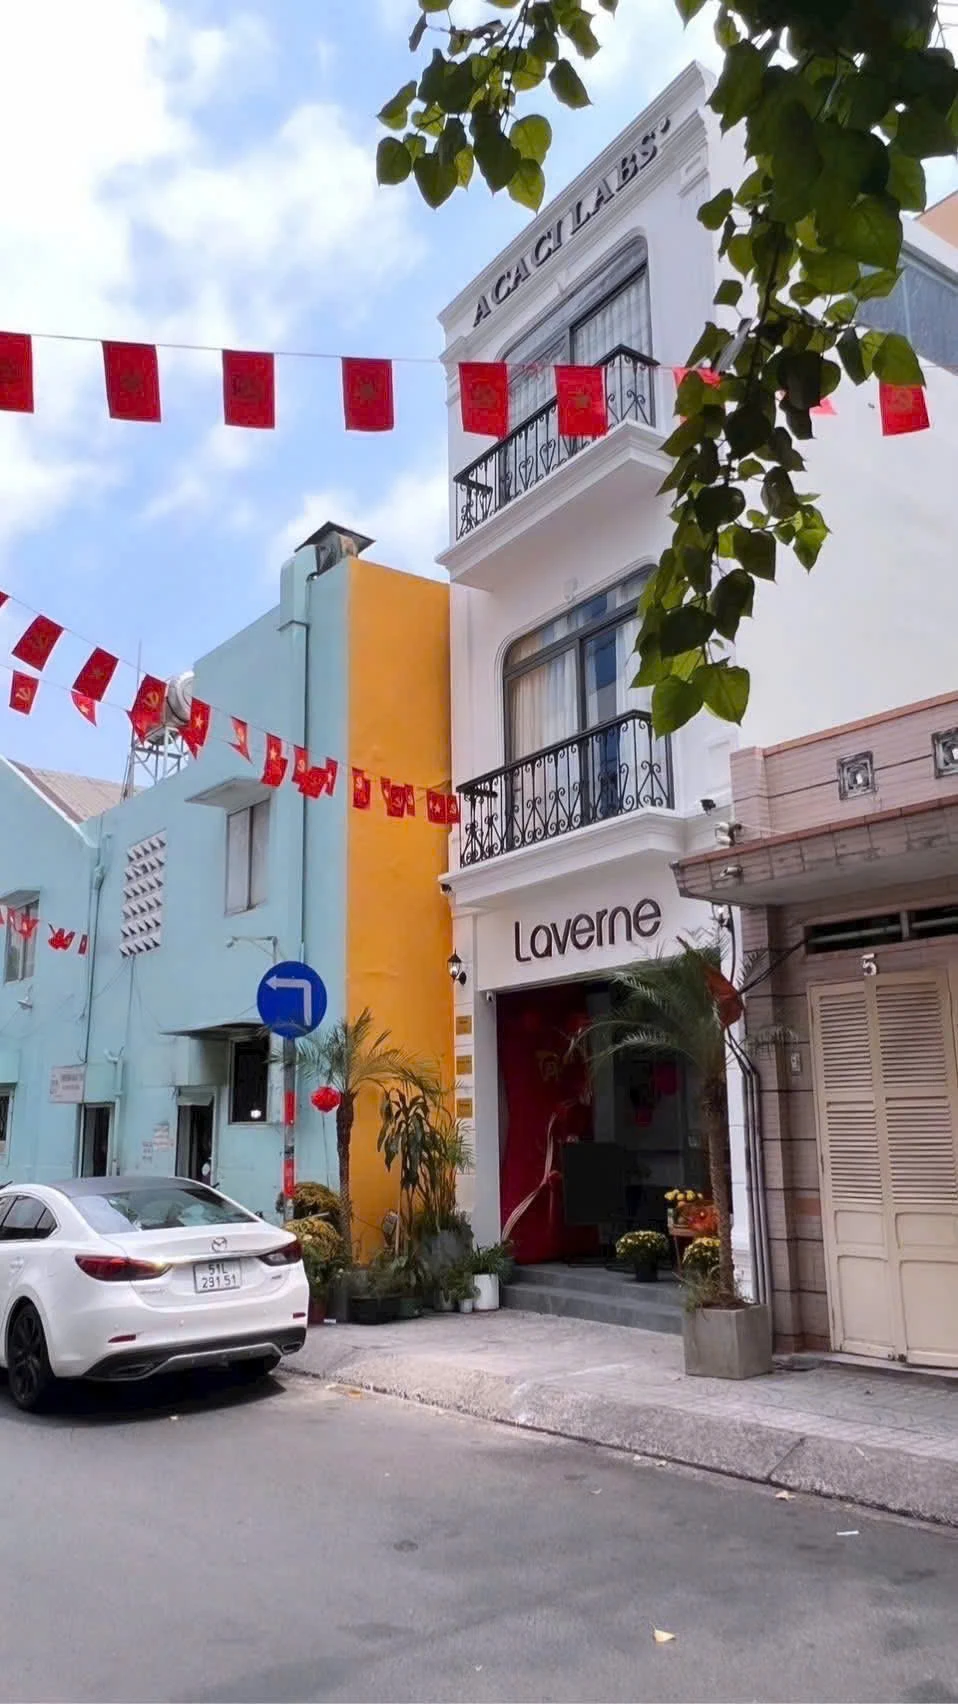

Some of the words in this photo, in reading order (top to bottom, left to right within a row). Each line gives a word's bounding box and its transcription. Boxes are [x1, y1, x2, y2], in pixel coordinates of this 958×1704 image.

[473, 220, 563, 327] ACACI
[514, 898, 662, 962] Laverne
[861, 952, 877, 977] 5
